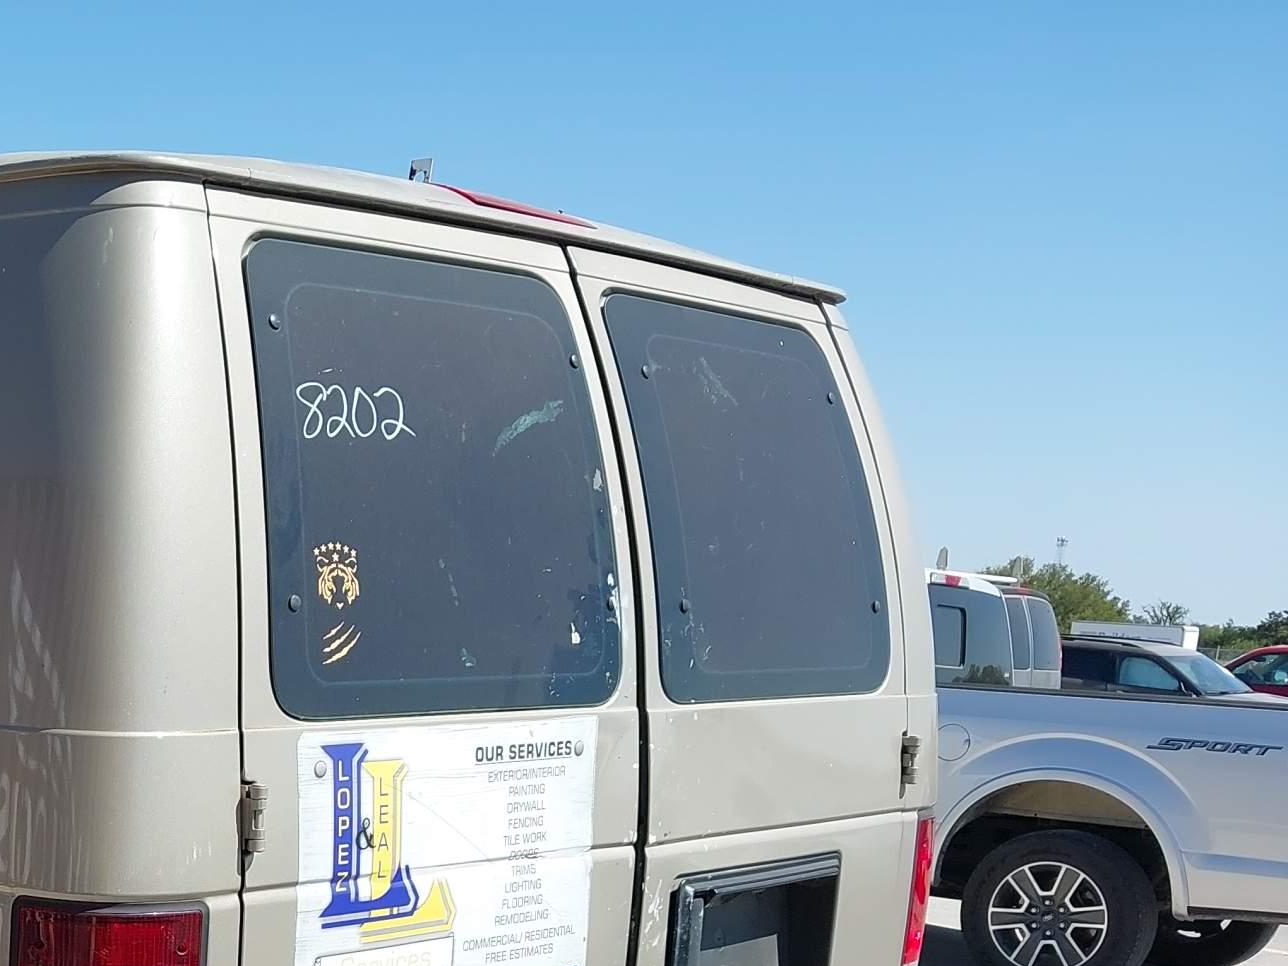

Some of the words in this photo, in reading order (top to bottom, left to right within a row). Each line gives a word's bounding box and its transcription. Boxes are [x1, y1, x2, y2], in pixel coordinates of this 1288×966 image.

[295, 381, 416, 440] 8202
[475, 745, 504, 763] OUR
[509, 740, 572, 760] SERVICES
[1147, 737, 1283, 756] SPORT
[487, 765, 566, 783] EXTERIOR/INTERIOR
[508, 783, 545, 797] PAINTING
[506, 800, 546, 814] DRYWALL
[335, 759, 353, 893] LOPEZ
[355, 818, 376, 850] &
[377, 777, 389, 879] LEAL
[508, 816, 544, 829] FENCING
[504, 834, 520, 847] TILE
[522, 831, 547, 844] WORK
[512, 864, 536, 876] TRIMS
[504, 878, 542, 893] LIGHTING
[501, 894, 543, 909] FLOORING
[494, 908, 549, 926] REMODELING
[524, 925, 575, 942] RESIDENTIAL
[485, 951, 507, 964] FREE
[509, 943, 553, 960] ESTIMATES
